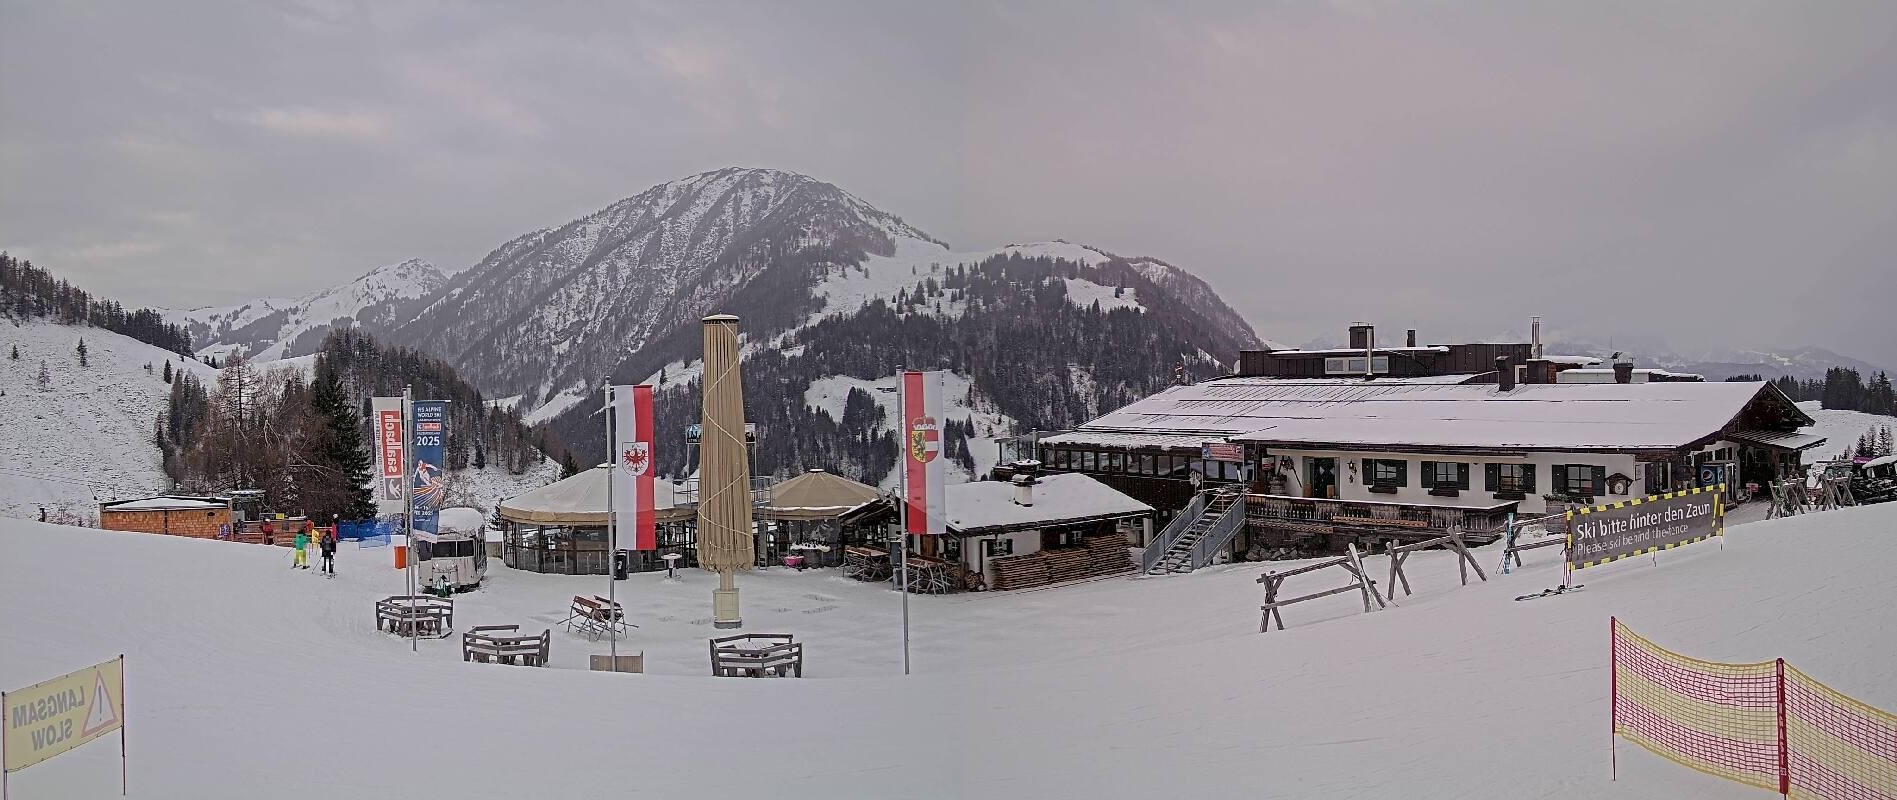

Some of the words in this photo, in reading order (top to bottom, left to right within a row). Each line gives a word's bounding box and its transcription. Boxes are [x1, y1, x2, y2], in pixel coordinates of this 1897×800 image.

[416, 436, 440, 446] 2025
[1577, 522, 1595, 540] Ski
[1599, 519, 1627, 536] bitte
[1630, 512, 1662, 530] hinter
[1664, 506, 1684, 522] den
[1686, 503, 1711, 518] Zaun
[1577, 542, 1608, 555] Please
[1609, 536, 1621, 549] ski
[1652, 526, 1667, 539] the
